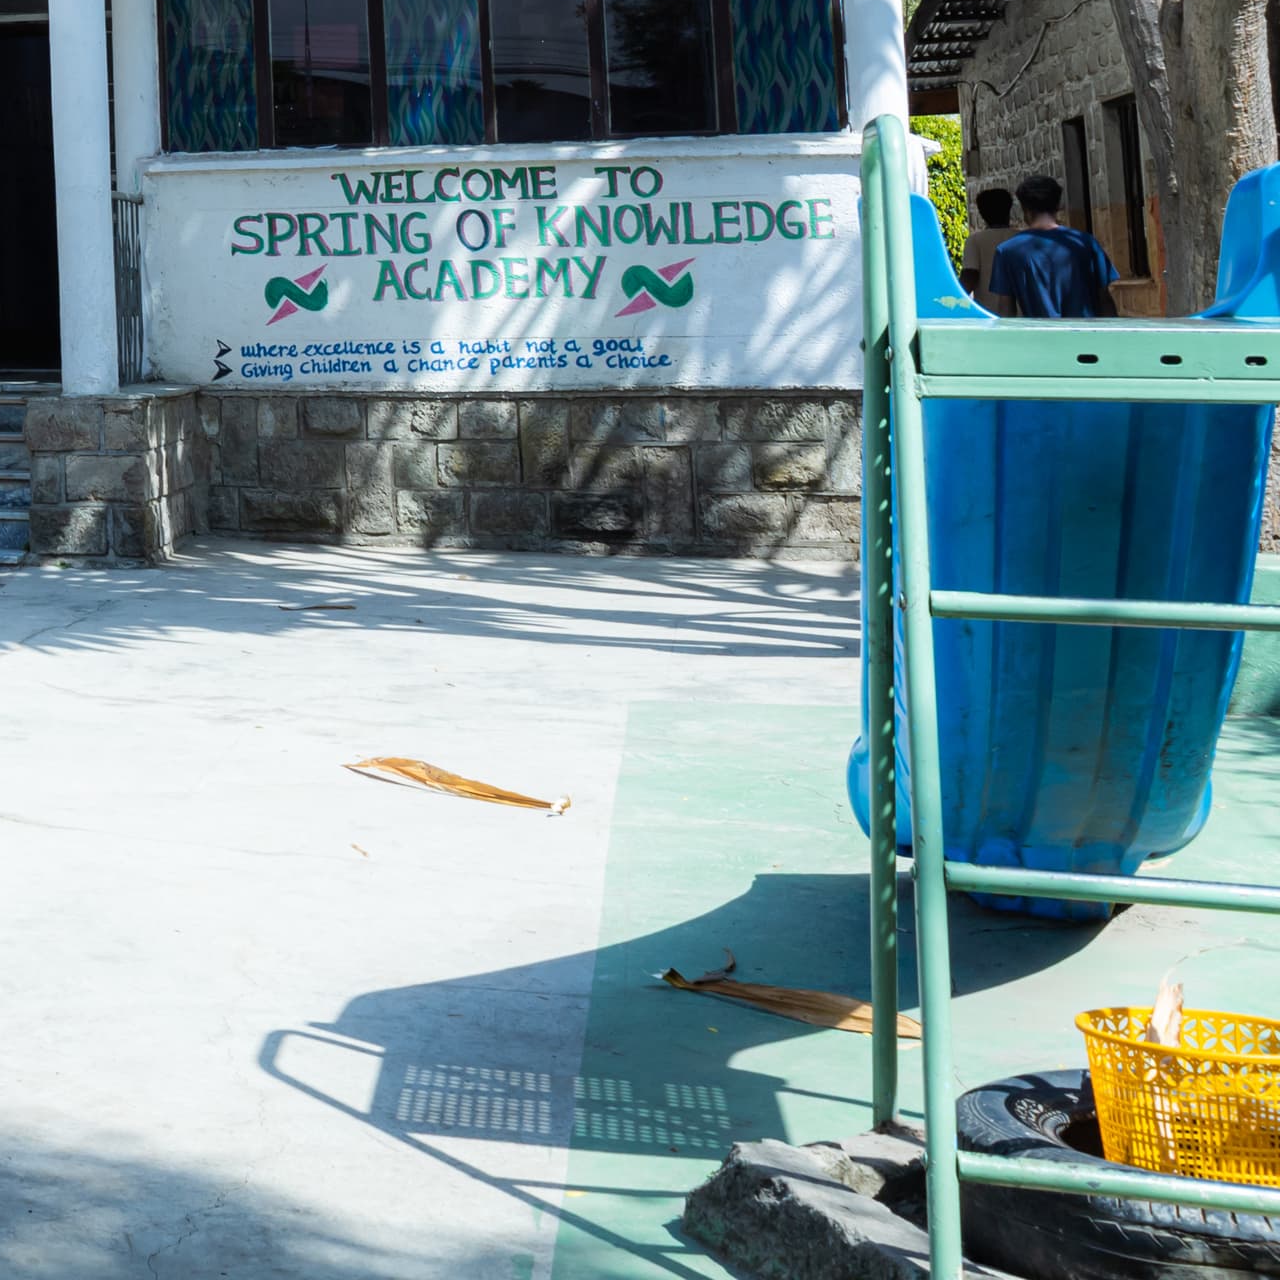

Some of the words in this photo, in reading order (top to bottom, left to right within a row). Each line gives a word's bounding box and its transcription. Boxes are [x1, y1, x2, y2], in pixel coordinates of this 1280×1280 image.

[330, 166, 558, 205] WELCOME
[594, 166, 663, 199] TO
[231, 211, 433, 257] SPRING
[455, 208, 517, 252] OF
[534, 198, 836, 248] KNOWLEDGE
[372, 255, 608, 301] ACADEMY
[240, 342, 299, 357] where
[301, 340, 397, 356] excellence
[402, 339, 421, 355] is
[429, 340, 445, 355] a
[458, 339, 511, 355] habit
[526, 338, 557, 355] not
[564, 339, 581, 352] a
[592, 336, 644, 356] goal
[240, 361, 293, 382] Giving
[383, 359, 399, 373] a
[489, 353, 568, 375] parents
[576, 354, 593, 368] a
